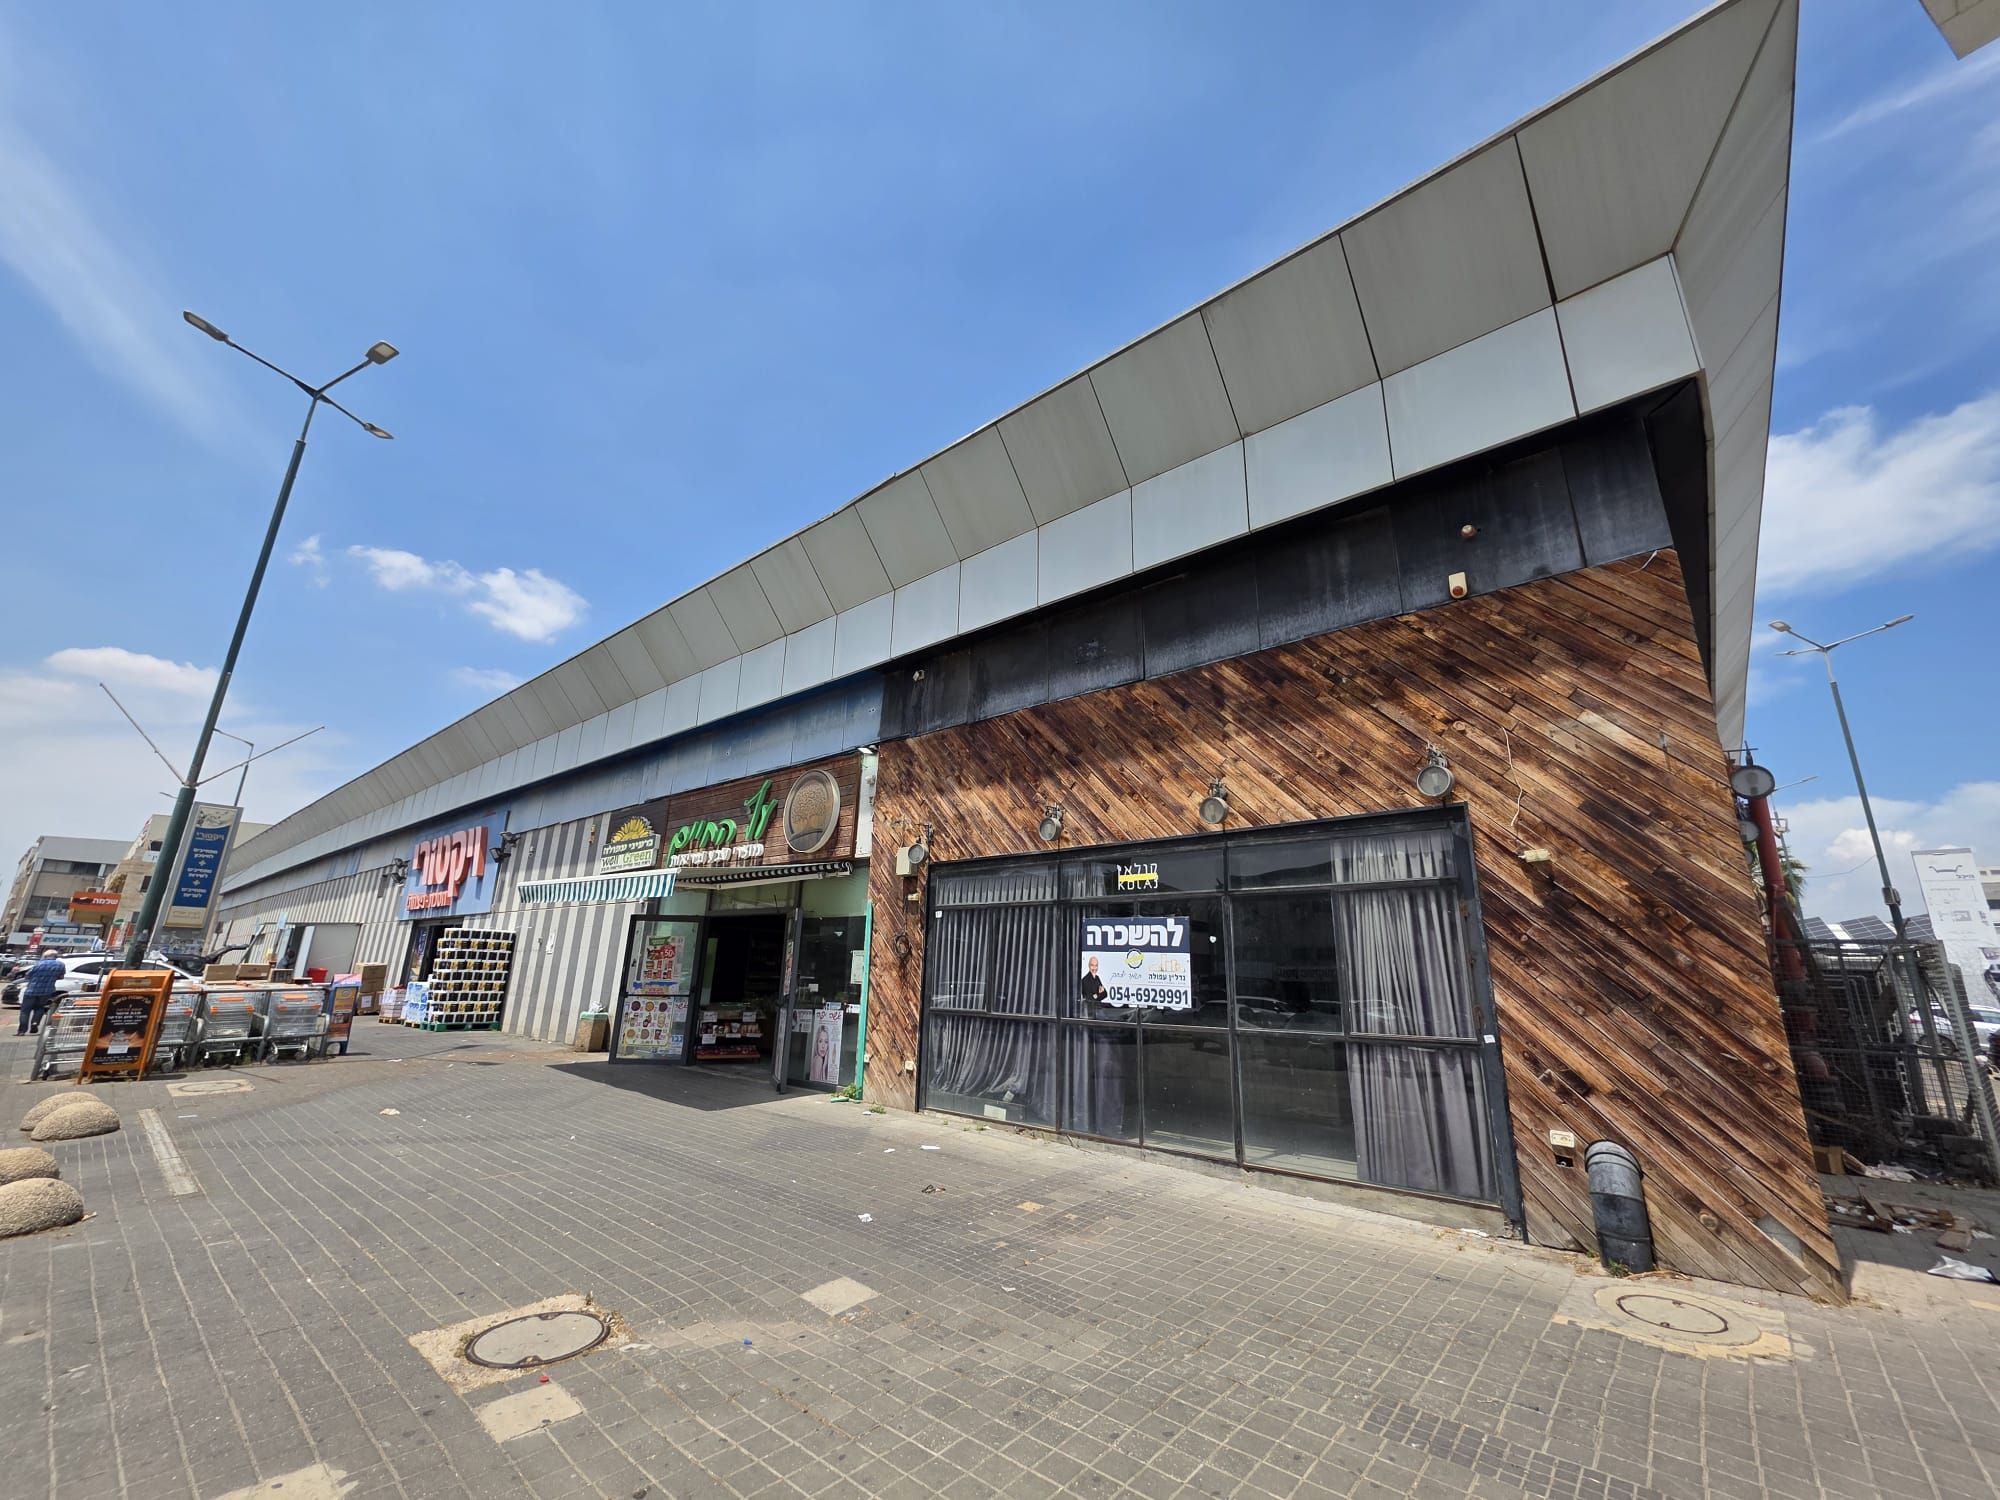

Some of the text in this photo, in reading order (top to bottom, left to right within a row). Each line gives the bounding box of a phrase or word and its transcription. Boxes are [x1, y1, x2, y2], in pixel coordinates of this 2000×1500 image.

[412, 826, 487, 898] ויקטורי
[1086, 918, 1184, 947] להשכרה
[1148, 972, 1167, 981] עפולה
[1109, 986, 1189, 1005] 054-6929991
